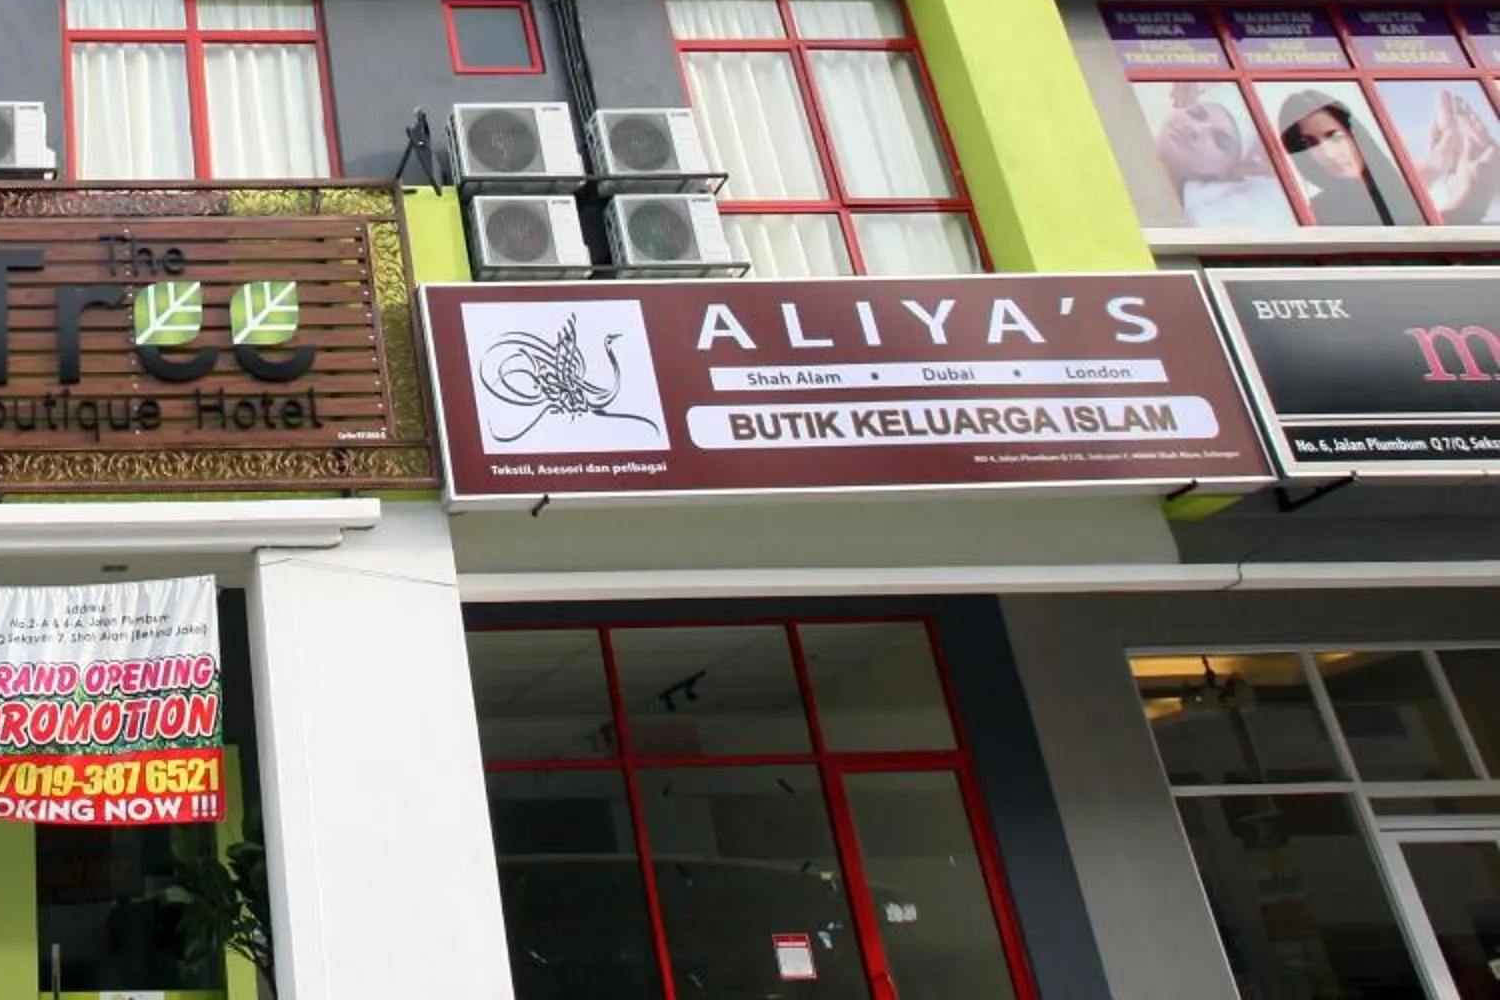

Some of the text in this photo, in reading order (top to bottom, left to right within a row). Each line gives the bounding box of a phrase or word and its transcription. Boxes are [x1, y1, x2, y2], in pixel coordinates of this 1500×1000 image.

[98, 235, 187, 277] The
[697, 297, 1159, 350] ALIYA'S
[1252, 299, 1351, 319] BUTIK
[747, 365, 1132, 386] Shah Alam Dubai London
[192, 386, 325, 431] Hotel
[728, 403, 1180, 441] BUTIK KELUARGA ISLAM
[1295, 438, 1318, 452] No.
[1334, 437, 1365, 451] Jalan
[1366, 436, 1427, 450] Plumbum
[586, 463, 610, 474] dan
[612, 461, 668, 475] pelbagai
[83, 655, 216, 694] OPENING
[145, 757, 219, 794] 6521
[104, 797, 182, 821] NOW
